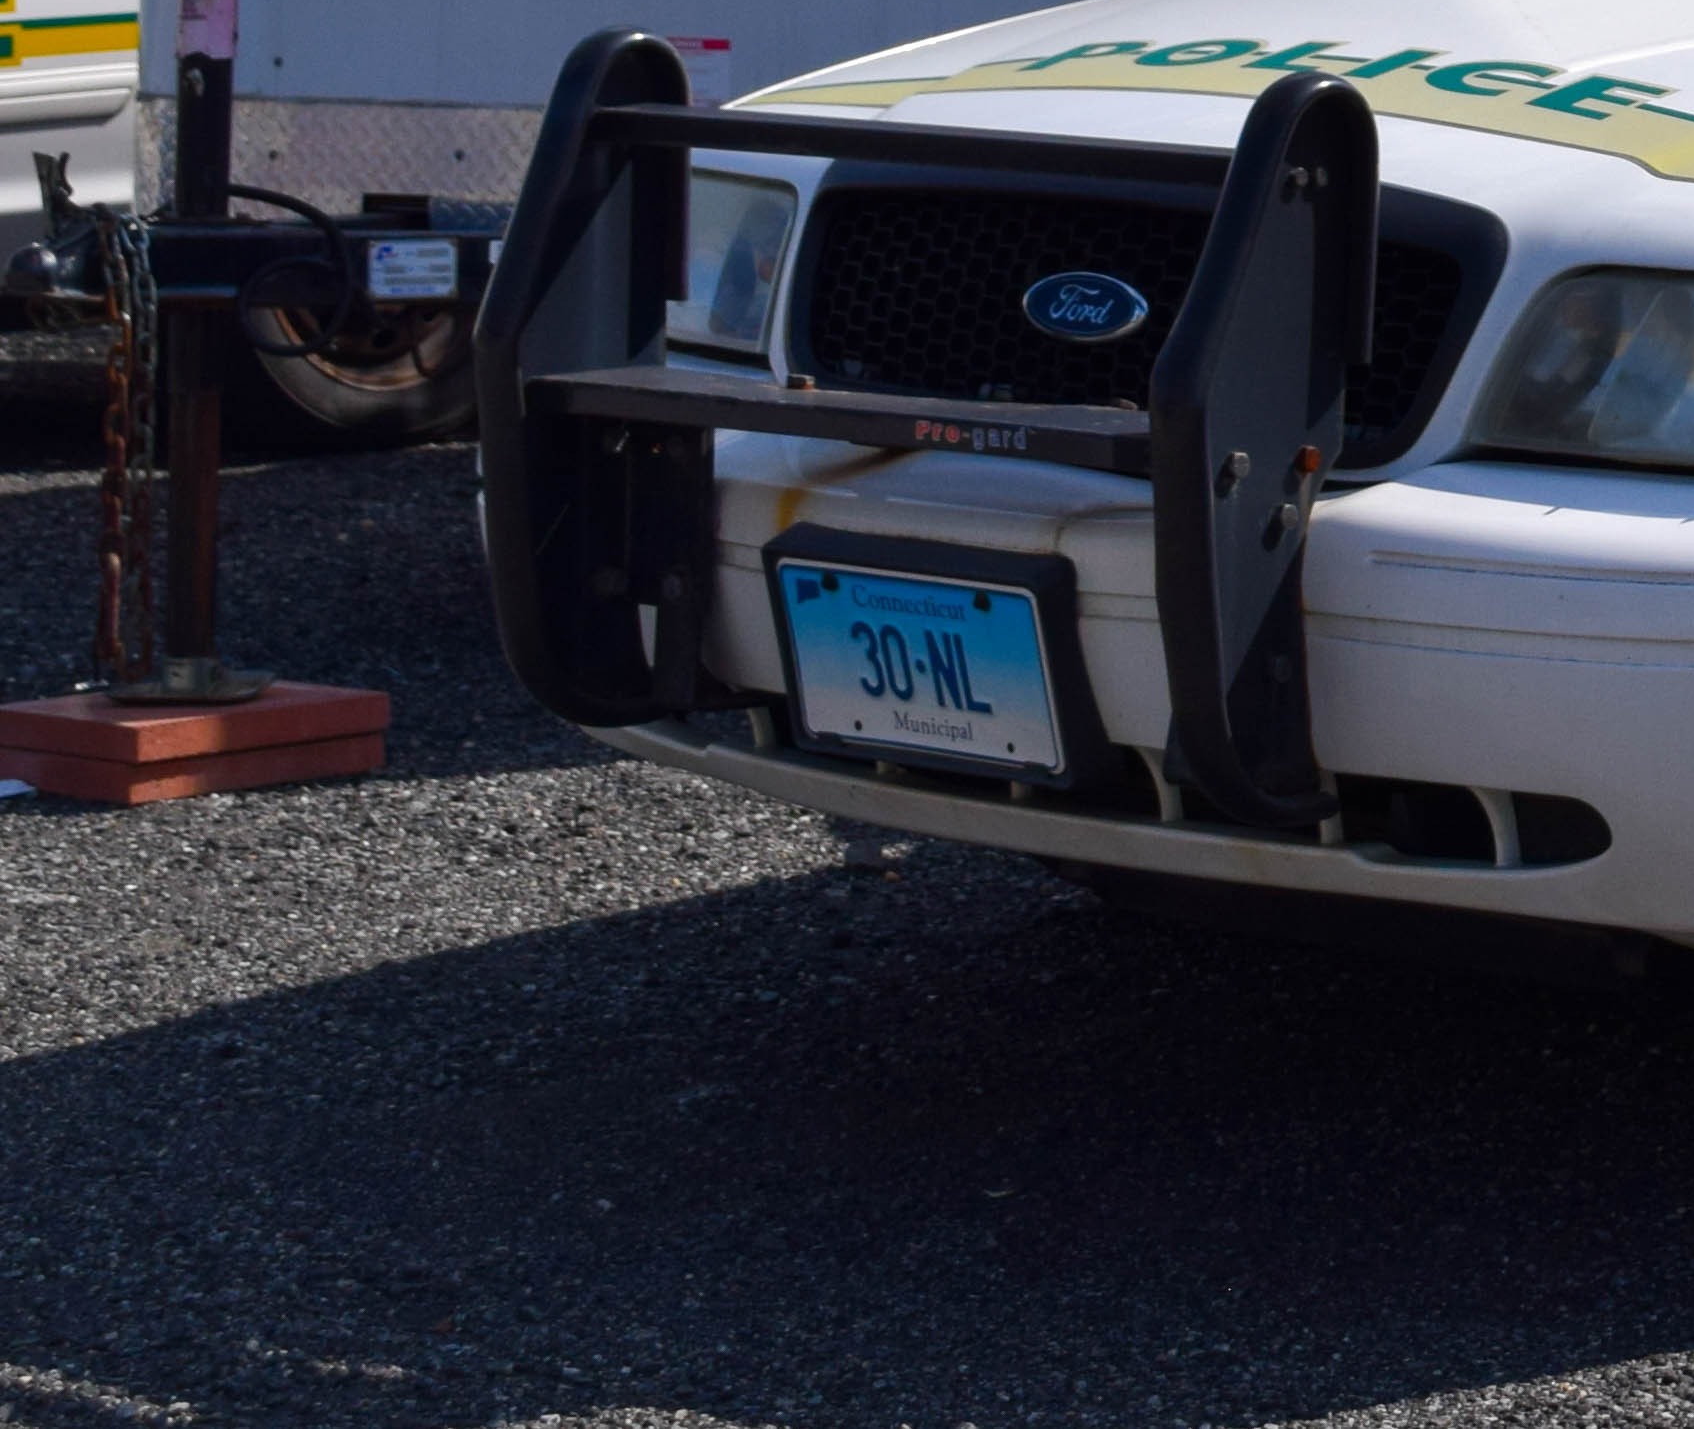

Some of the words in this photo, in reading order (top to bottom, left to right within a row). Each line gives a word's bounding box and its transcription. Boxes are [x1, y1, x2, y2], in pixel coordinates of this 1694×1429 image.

[1017, 39, 1668, 120] POLICE
[1050, 284, 1115, 324] Ford
[852, 584, 967, 622] Connecticut
[893, 709, 974, 742] Municipal
